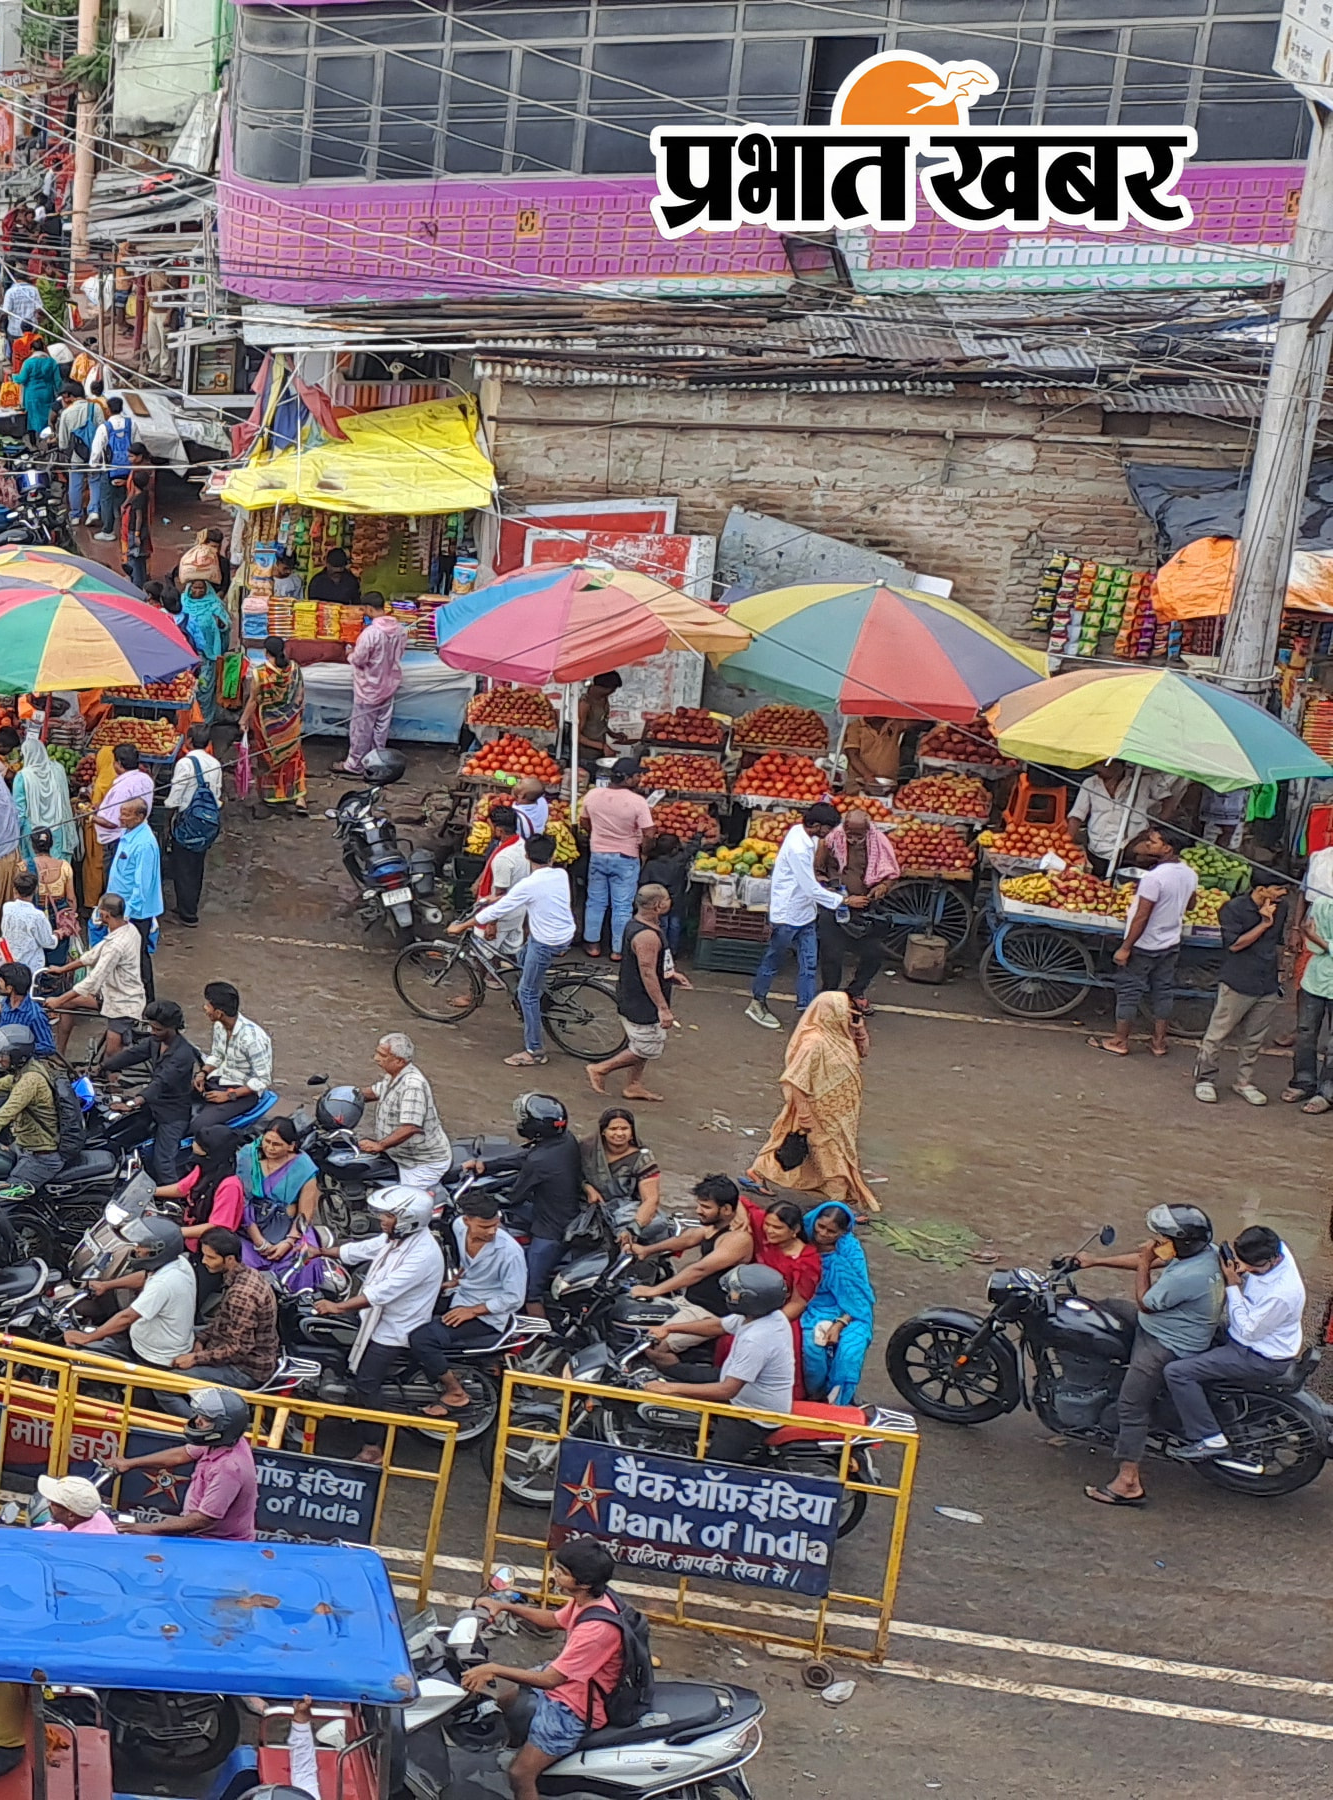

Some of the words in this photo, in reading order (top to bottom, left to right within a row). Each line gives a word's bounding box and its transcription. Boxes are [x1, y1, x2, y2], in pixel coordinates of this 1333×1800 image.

[297, 1468, 366, 1501] इंडिया
[614, 1455, 677, 1502] बैंक
[748, 1478, 837, 1526] इंडिया
[266, 1497, 294, 1514] of
[299, 1498, 360, 1526] India
[607, 1503, 694, 1546] Bank
[700, 1521, 736, 1551] of
[743, 1523, 828, 1566] India
[672, 1553, 733, 1577] आपकी
[731, 1558, 771, 1583] सेवा
